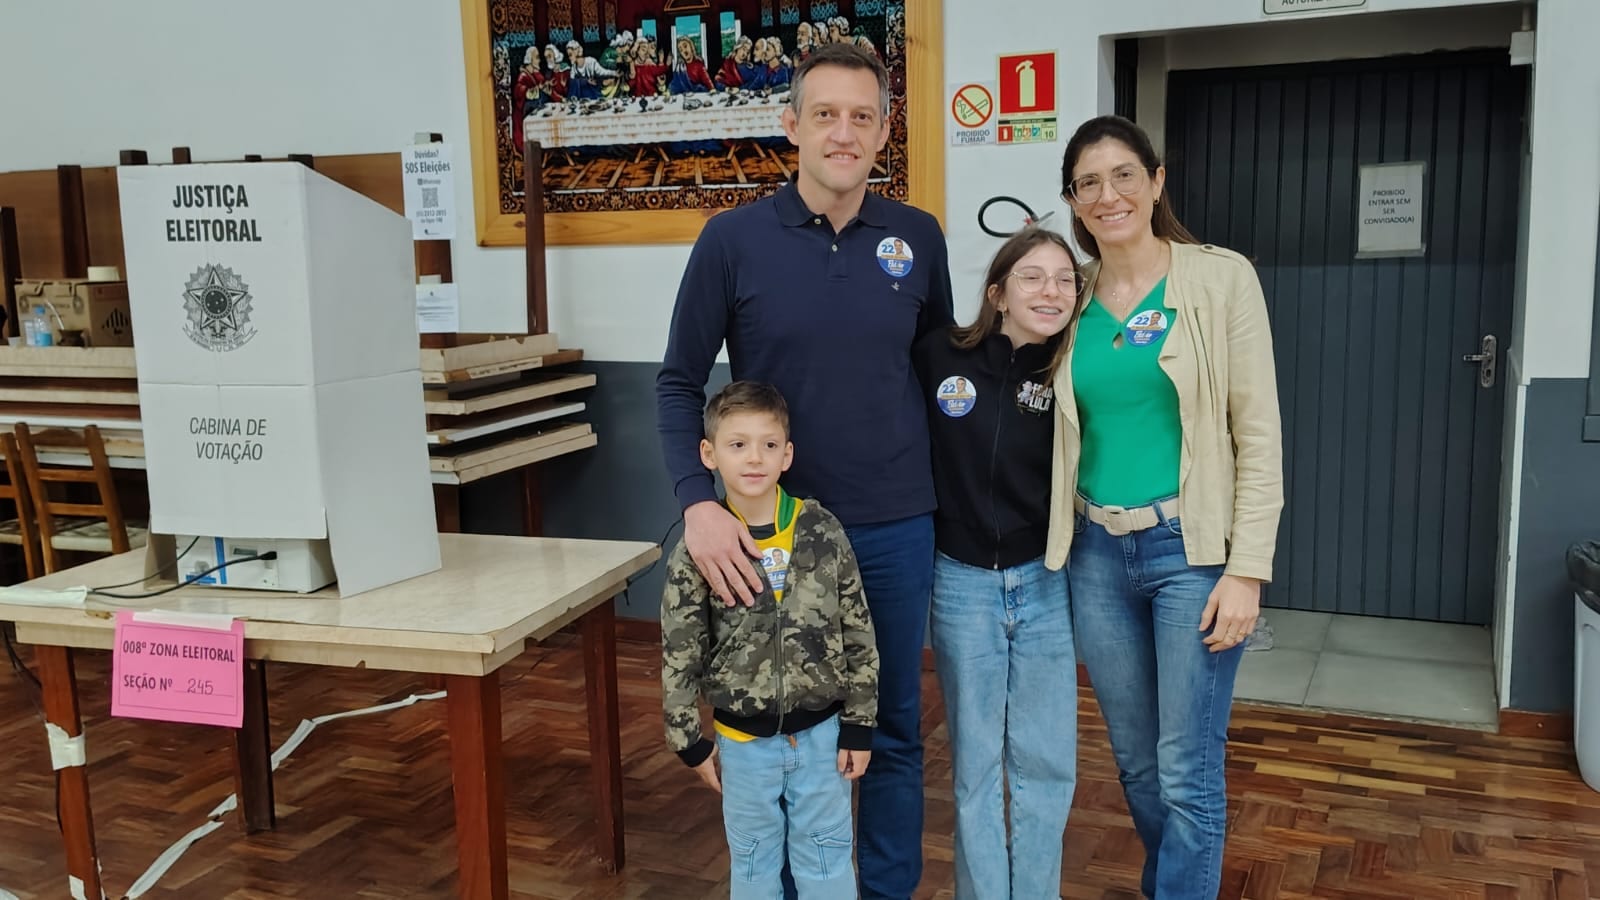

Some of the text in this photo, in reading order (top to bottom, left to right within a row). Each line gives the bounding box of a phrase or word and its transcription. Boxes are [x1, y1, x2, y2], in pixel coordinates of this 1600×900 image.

[956, 129, 990, 137] PROIBIDO
[1045, 130, 1054, 138] 10
[414, 150, 439, 159] Dúvidas?
[405, 161, 451, 174] SOS Eleições
[172, 184, 249, 214] JUSTIÇA
[1372, 189, 1406, 197] PROIBIDO
[1368, 199, 1394, 207] ENTRAR
[1364, 216, 1415, 225] CONVIDADO(A)
[166, 219, 262, 242] ELEITORAL
[881, 244, 895, 254] 22
[1134, 316, 1149, 325] 22
[943, 383, 956, 394] 22
[1029, 395, 1050, 411] LULA
[190, 417, 267, 436] CABINA DE
[196, 440, 263, 464] VOTAÇÃO
[150, 642, 179, 658] ZONA
[183, 645, 236, 663] ELEITORAL
[124, 673, 173, 693] SEÇÃO Nº
[187, 678, 214, 695] 245
